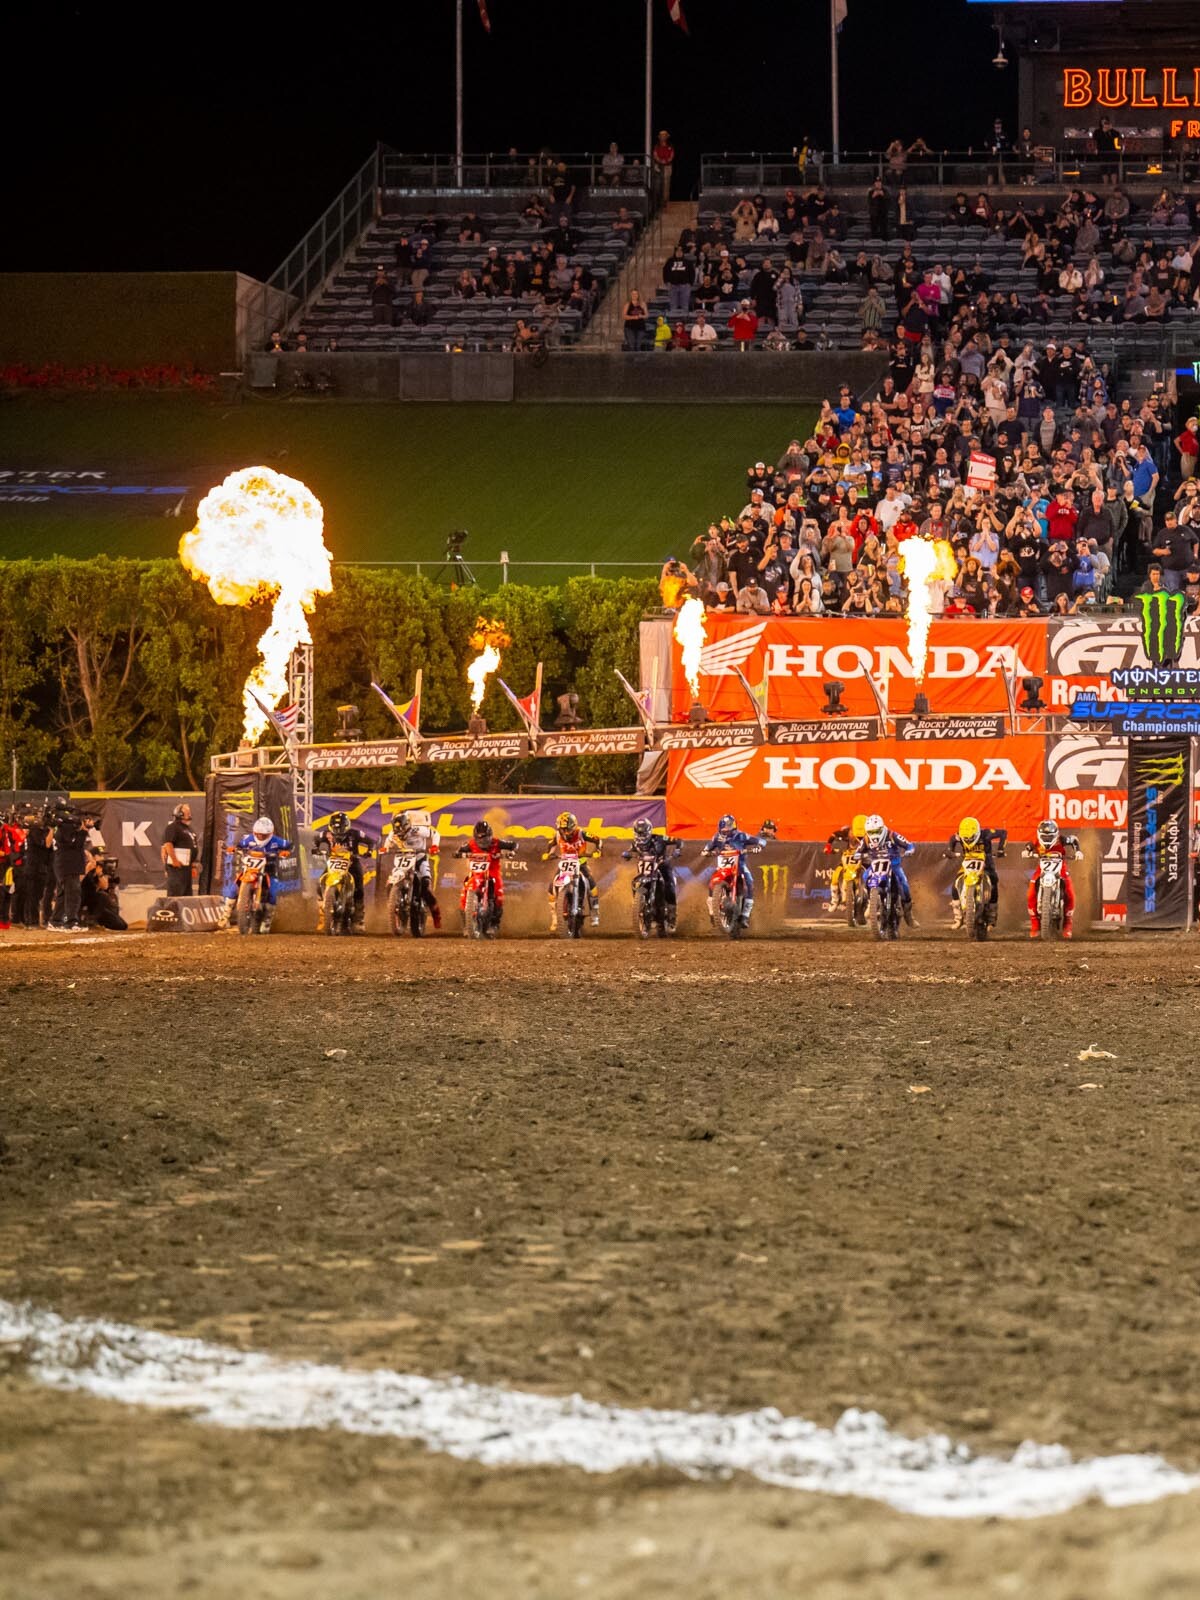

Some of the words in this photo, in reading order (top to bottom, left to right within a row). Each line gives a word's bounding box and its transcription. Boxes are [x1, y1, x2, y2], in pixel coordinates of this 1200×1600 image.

[767, 645, 1033, 679] HONDA
[1077, 692, 1097, 702] AMA
[789, 723, 816, 732] ROCKY
[818, 721, 869, 731] MOUNTAIN
[912, 721, 939, 730] ROCKY
[941, 719, 998, 729] MOUNTAIN
[675, 728, 701, 738] ROCKY
[703, 727, 755, 737] MOUNTAIN
[558, 735, 587, 744] ROCKY
[589, 733, 638, 742] MOUNTAIN
[442, 741, 470, 750] ROCKY
[472, 739, 521, 748] MOUNTAIN
[320, 749, 349, 757] ROCKY
[351, 746, 399, 756] MOUNTAIN
[763, 757, 1031, 791] HONDA
[1167, 813, 1179, 883] MONSTER
[329, 860, 348, 871] 722
[396, 856, 411, 868] 15
[471, 862, 488, 871] 54
[560, 861, 577, 872] 95
[872, 860, 890, 872] 11
[965, 861, 981, 871] 41
[1042, 861, 1060, 872] 27
